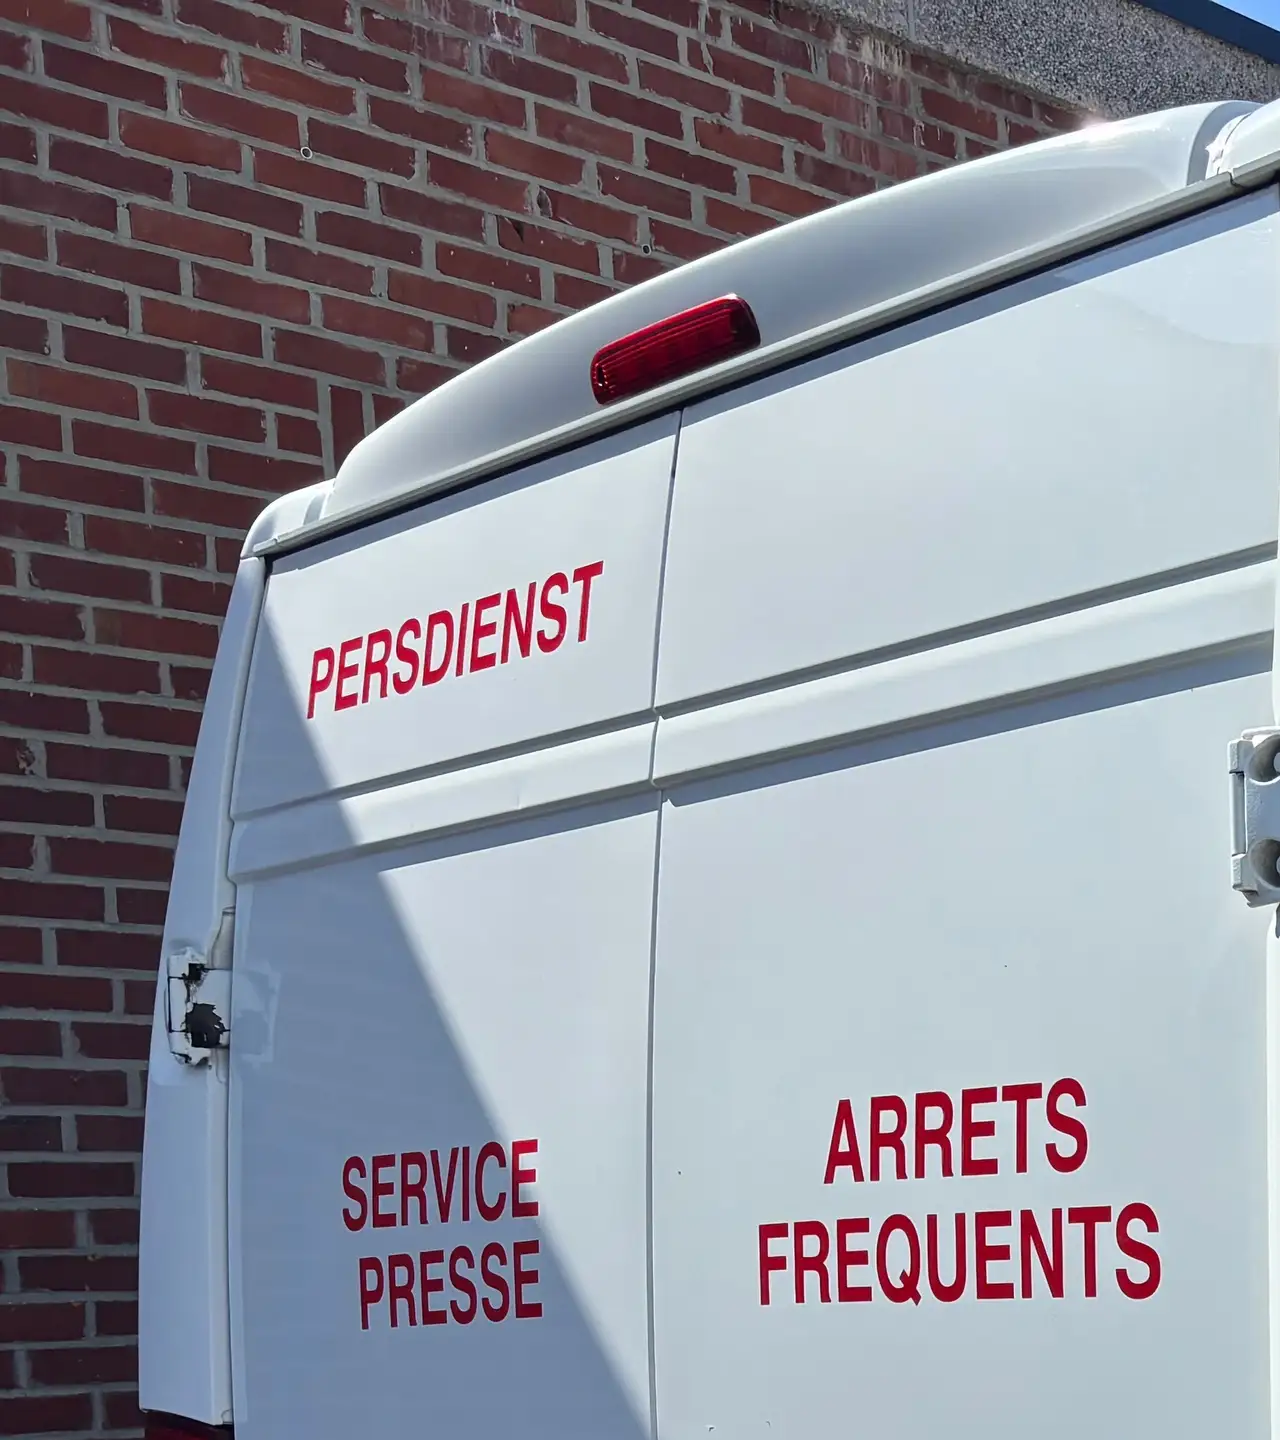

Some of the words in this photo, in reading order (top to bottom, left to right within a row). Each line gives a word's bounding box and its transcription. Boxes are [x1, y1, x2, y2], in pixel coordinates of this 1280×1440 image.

[307, 560, 604, 719] PERSDIENST
[823, 1077, 1088, 1184] ARRETS
[342, 1138, 539, 1232] SERVICE
[358, 1239, 543, 1330] PRESSE
[758, 1202, 1161, 1306] FREQUENTS
